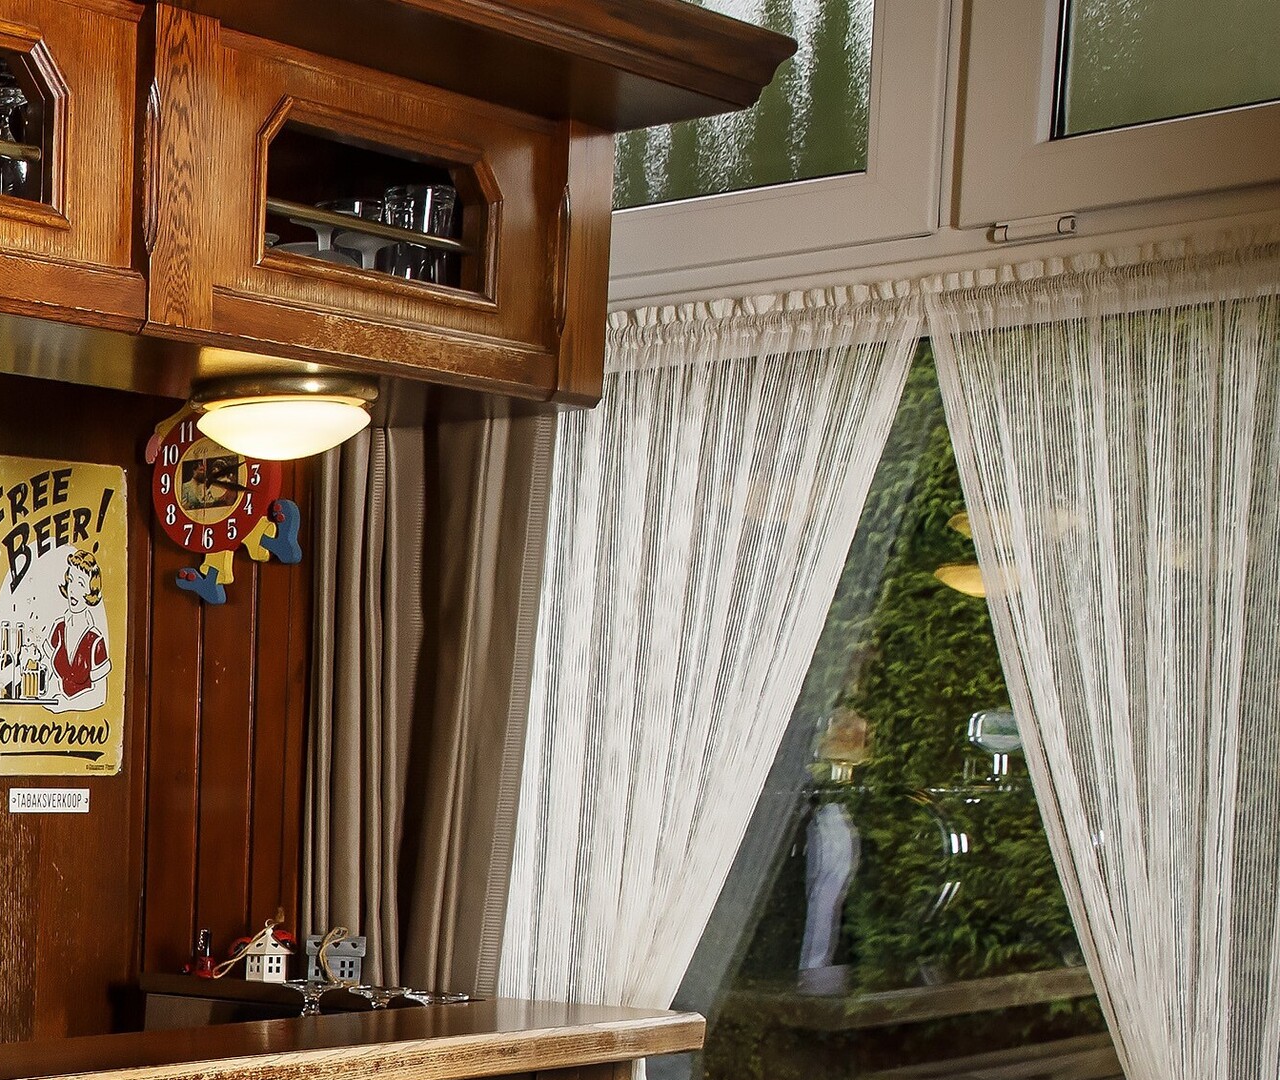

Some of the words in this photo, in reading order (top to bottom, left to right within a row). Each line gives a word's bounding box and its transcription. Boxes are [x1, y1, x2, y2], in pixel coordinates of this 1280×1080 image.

[178, 420, 194, 443] 11
[162, 444, 179, 467] 10
[160, 473, 172, 495] 9
[250, 463, 261, 486] 3
[165, 504, 177, 526] 8
[243, 493, 253, 515] 4
[183, 524, 194, 546] 7
[202, 527, 214, 550] 6
[226, 518, 238, 540] 5
[16, 793, 82, 808] TABAKSVERKOOP
